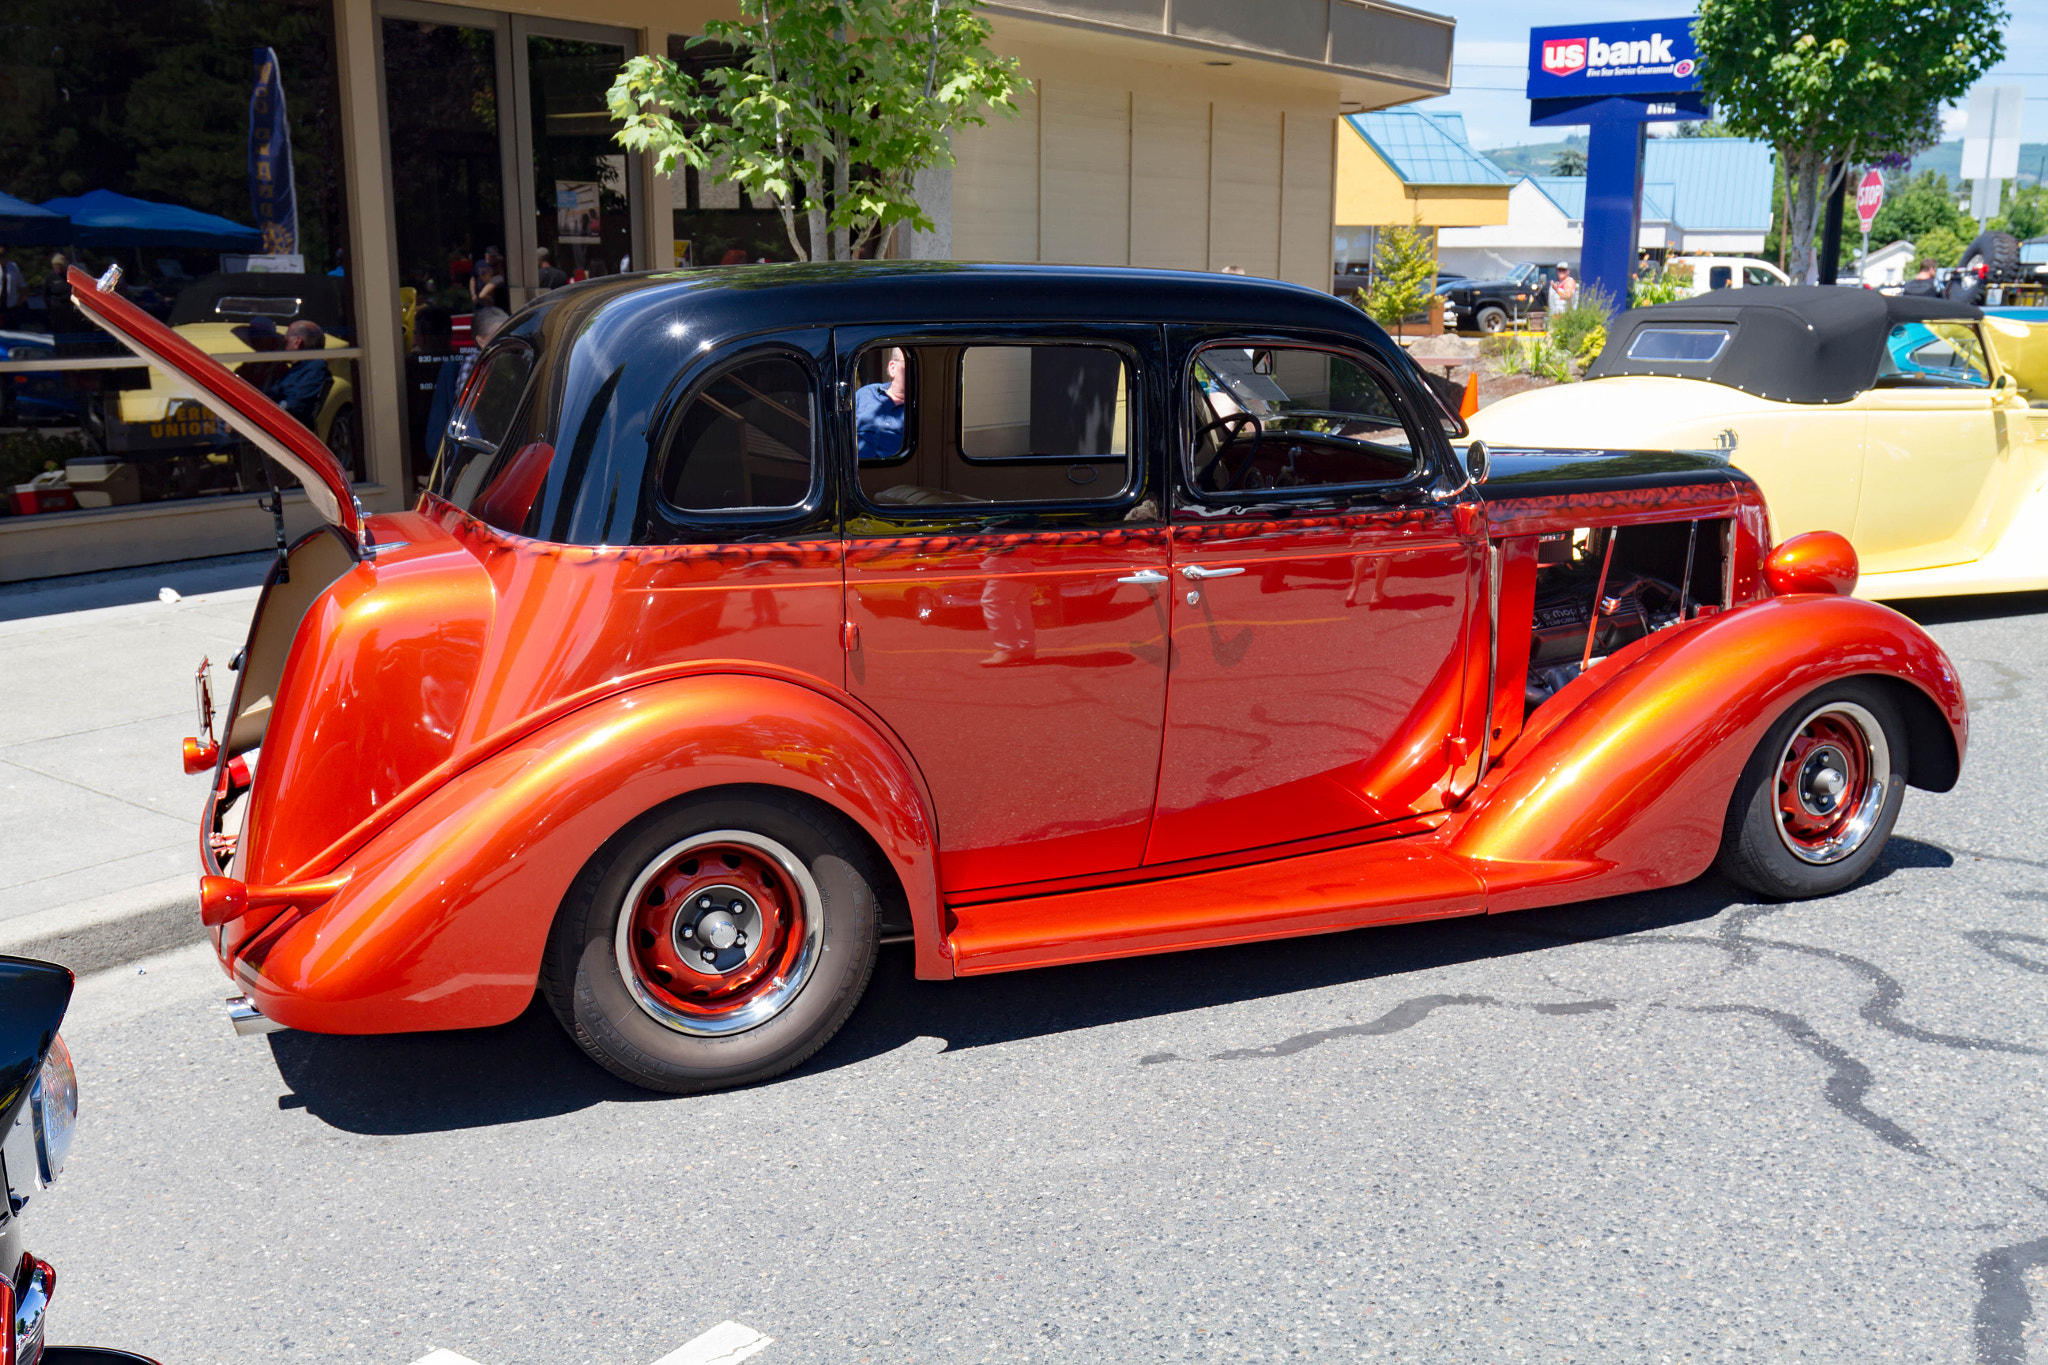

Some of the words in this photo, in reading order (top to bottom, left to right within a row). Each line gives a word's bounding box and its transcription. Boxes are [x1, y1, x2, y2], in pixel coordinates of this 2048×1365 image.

[1544, 44, 1584, 69] us
[1587, 33, 1674, 67] bank
[1586, 68, 1601, 78] Five
[1600, 67, 1614, 77] Star
[1614, 66, 1637, 76] Service
[1636, 64, 1674, 75] Guaranteed
[1646, 102, 1677, 115] ATM
[1859, 184, 1881, 206] STOP
[150, 421, 216, 438] UNION
